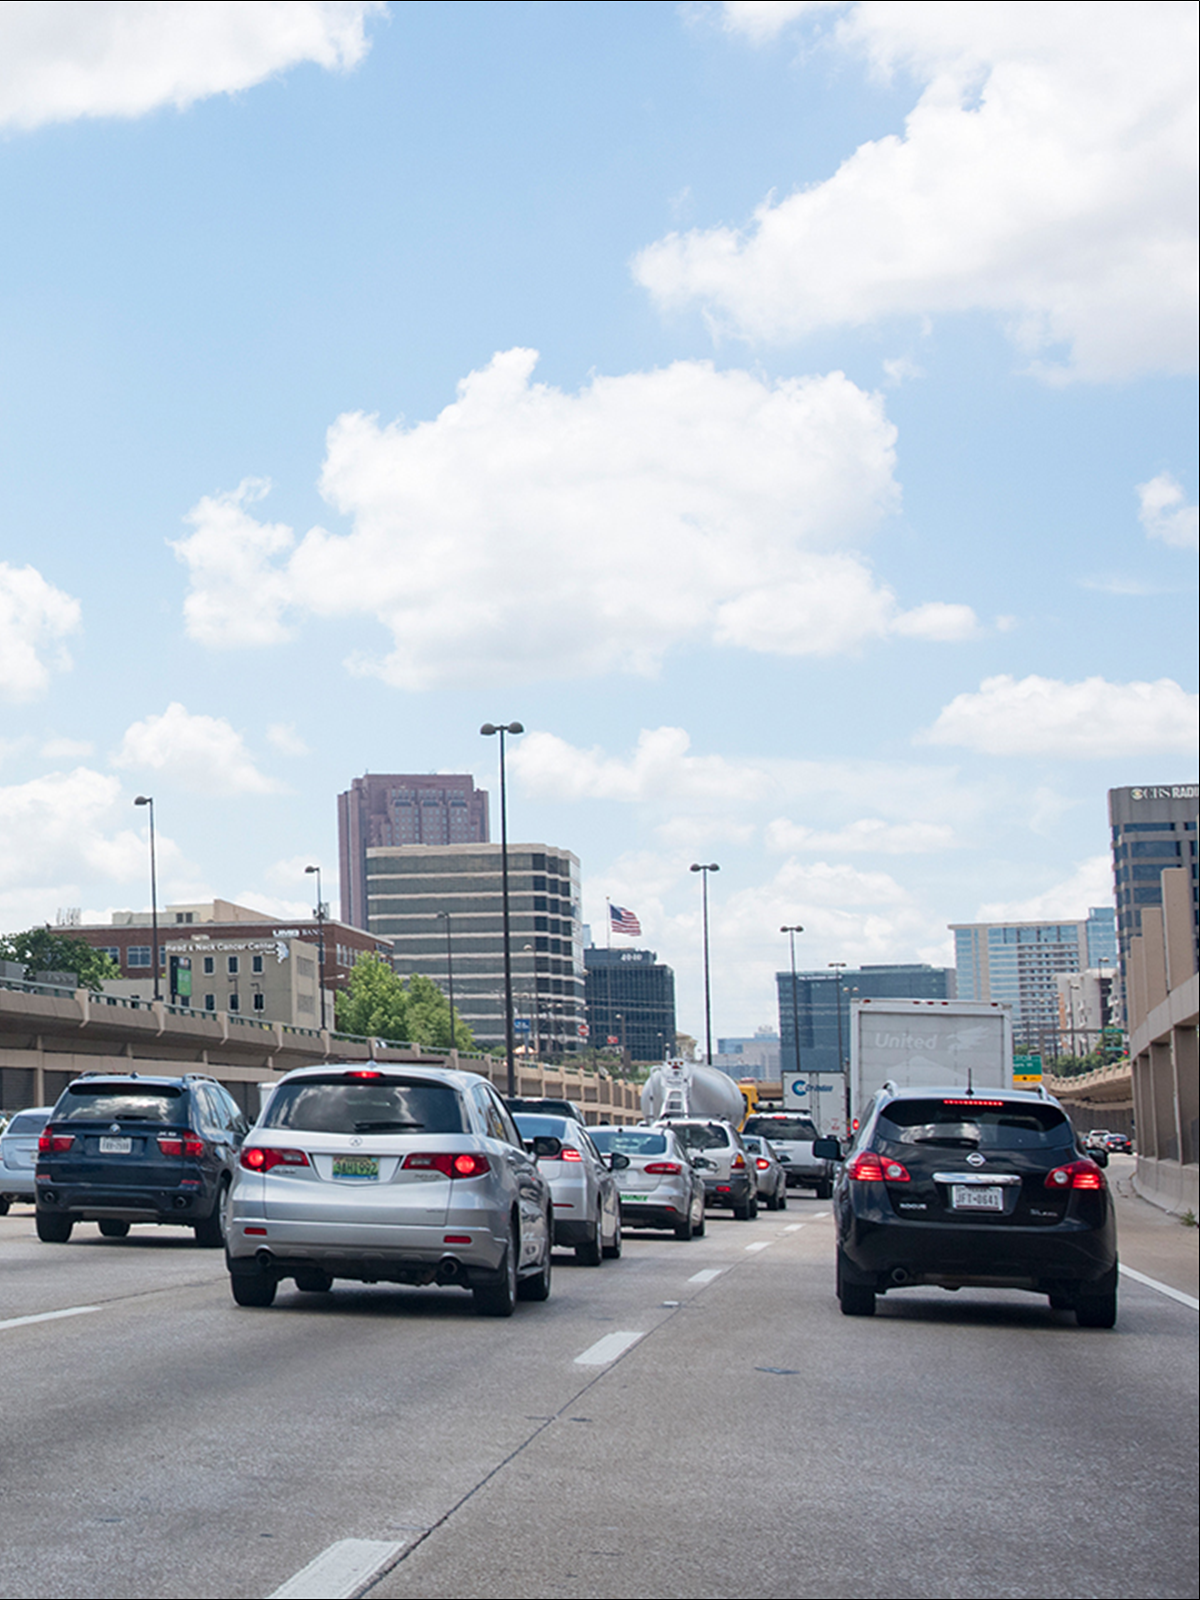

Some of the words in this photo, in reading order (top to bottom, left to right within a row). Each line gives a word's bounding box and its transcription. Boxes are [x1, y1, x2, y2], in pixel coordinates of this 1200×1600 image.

[1142, 787, 1171, 799] CBS
[1172, 786, 1199, 799] RADI
[165, 943, 187, 952] Head
[195, 943, 215, 951] Neck
[217, 942, 247, 951] Cancer
[248, 941, 277, 951] Center
[875, 1033, 938, 1050] United
